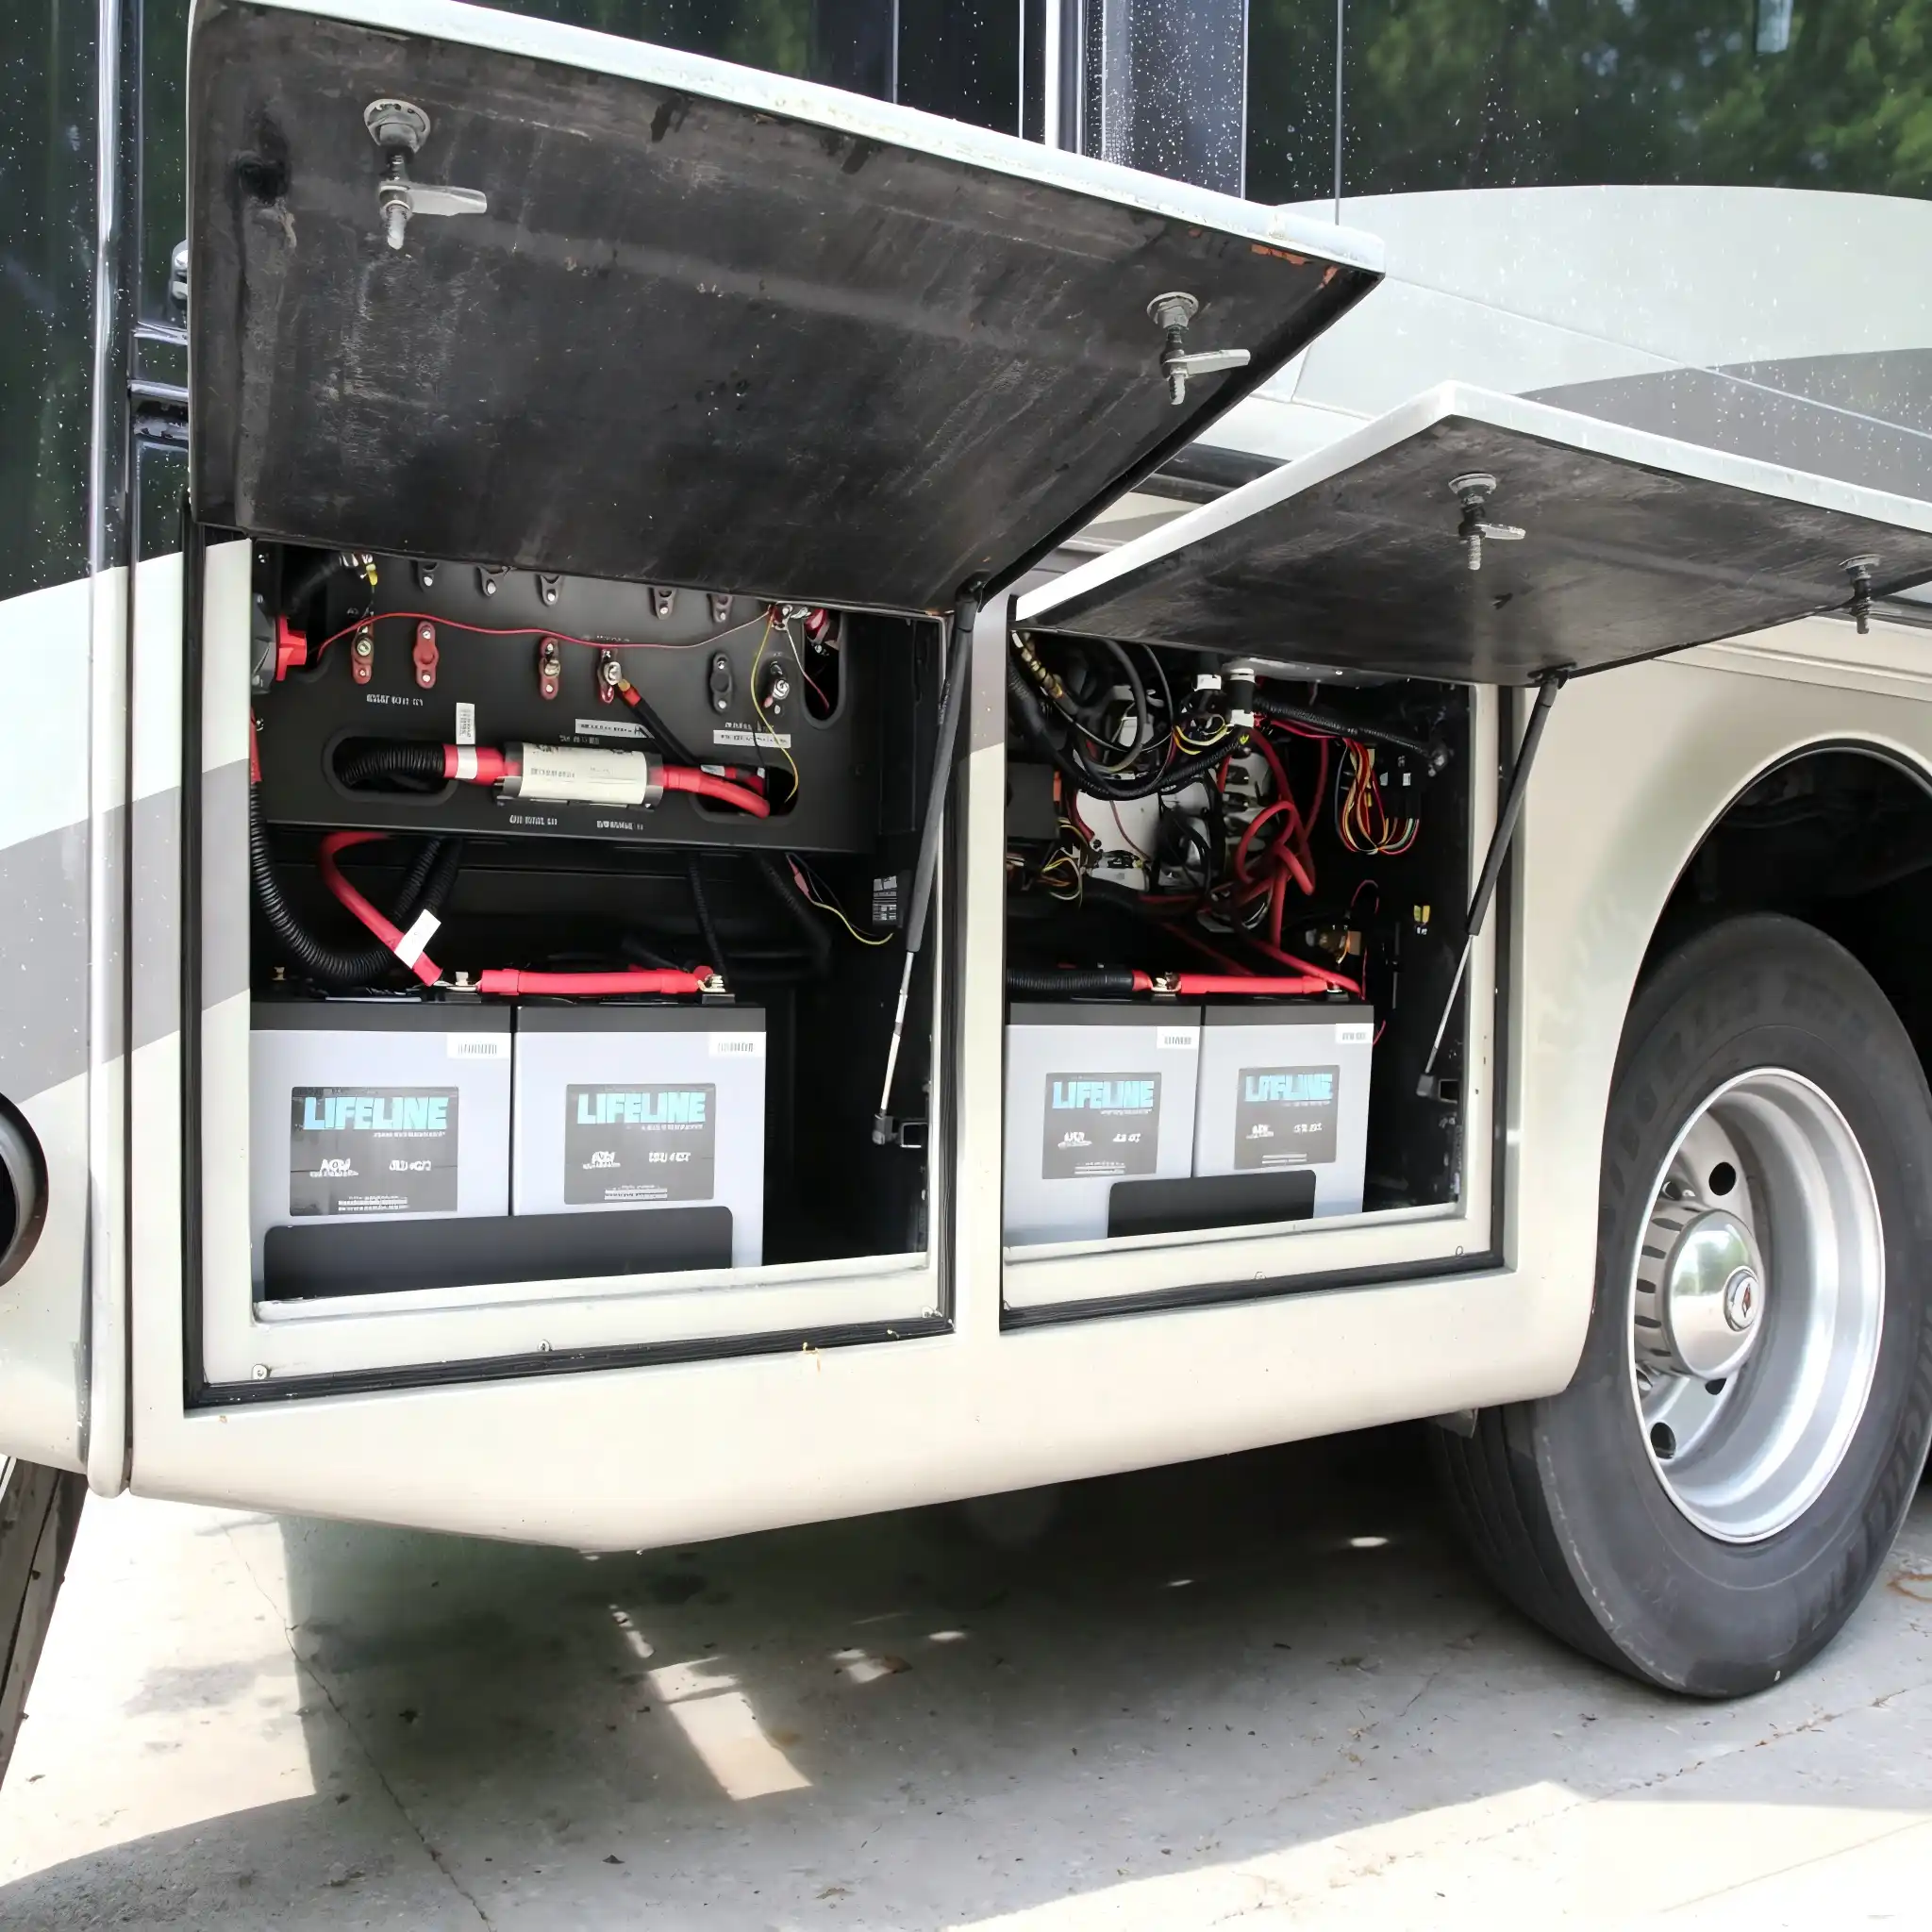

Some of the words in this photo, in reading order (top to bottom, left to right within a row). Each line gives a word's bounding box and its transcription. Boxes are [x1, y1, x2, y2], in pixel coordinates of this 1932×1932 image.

[578, 1092, 706, 1124] LIFELINE
[1052, 1081, 1155, 1109] LIFELINE
[303, 1097, 449, 1130] LIFELINE
